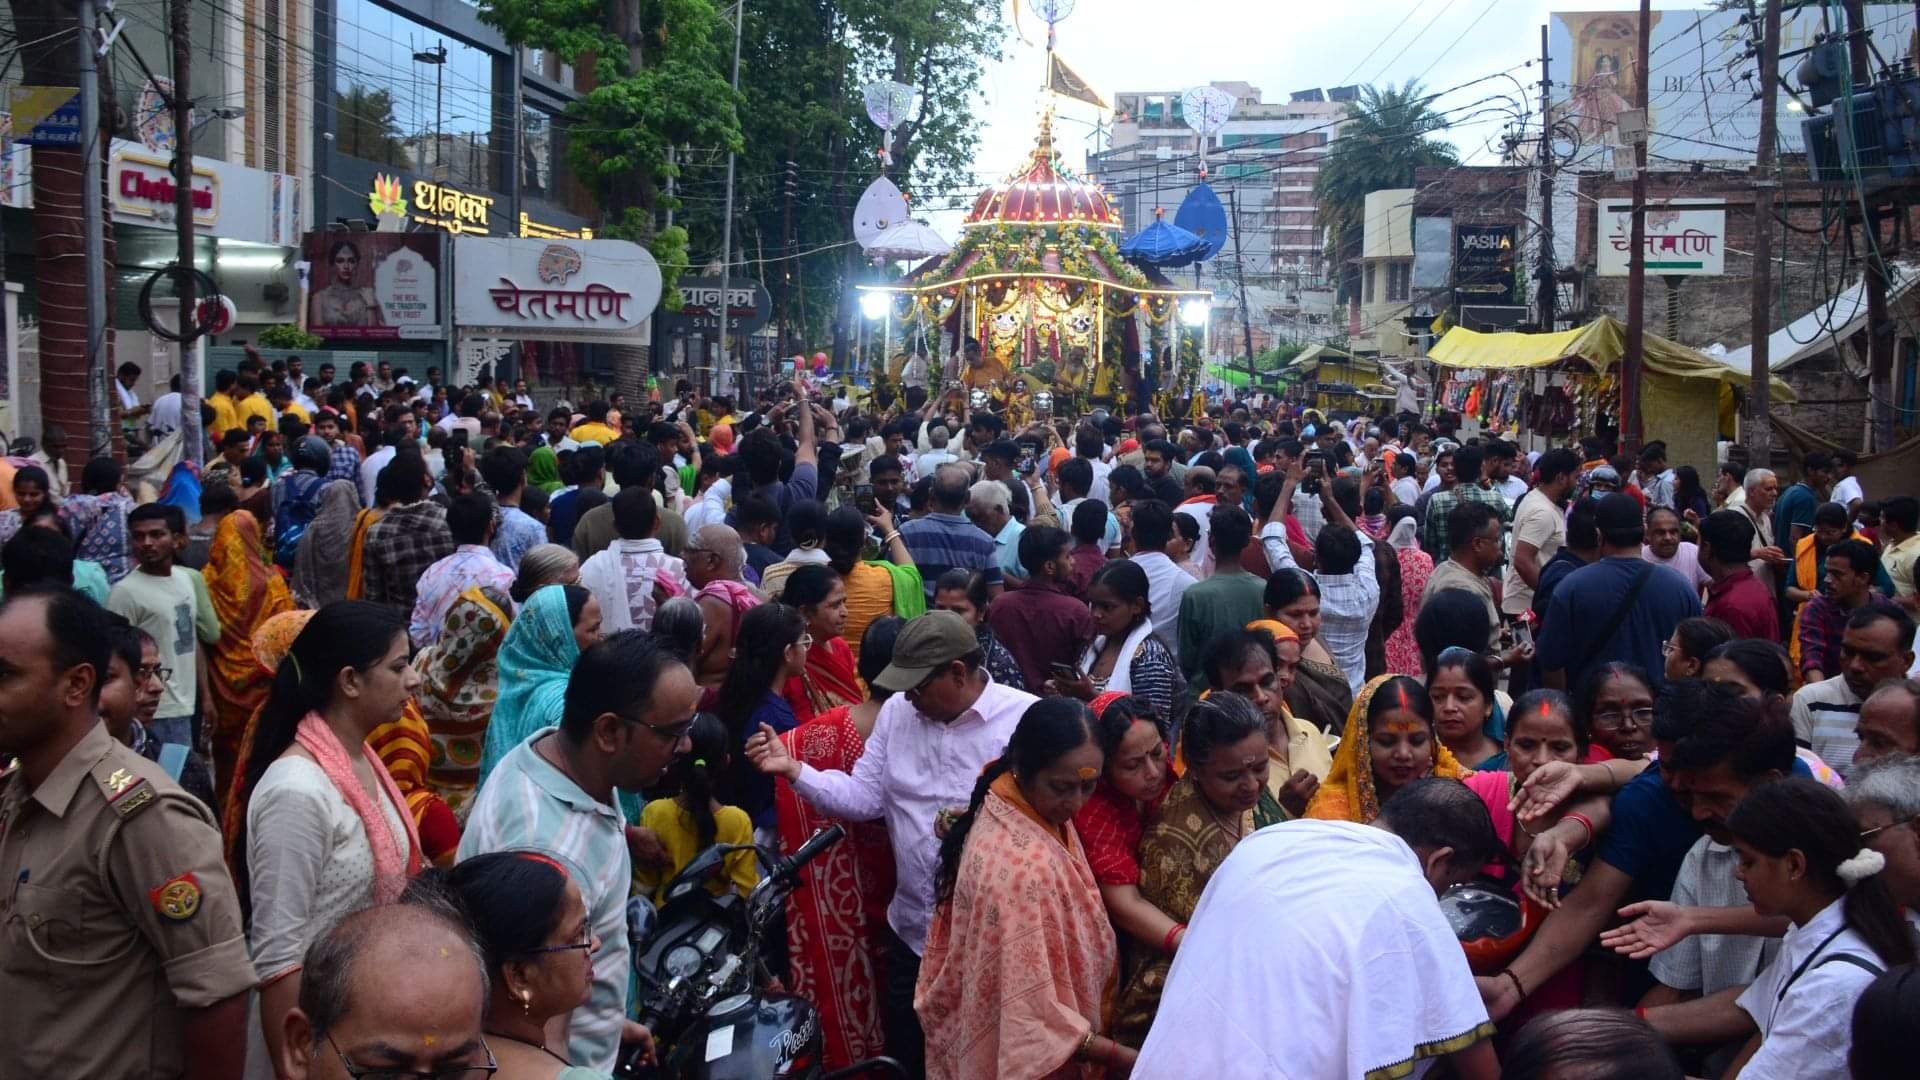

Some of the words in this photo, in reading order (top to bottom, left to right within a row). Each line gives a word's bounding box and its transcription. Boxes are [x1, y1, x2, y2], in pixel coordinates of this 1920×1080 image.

[1461, 234, 1511, 249] YASHA
[488, 277, 633, 322] चेतमणि
[693, 318, 740, 328] SILS
